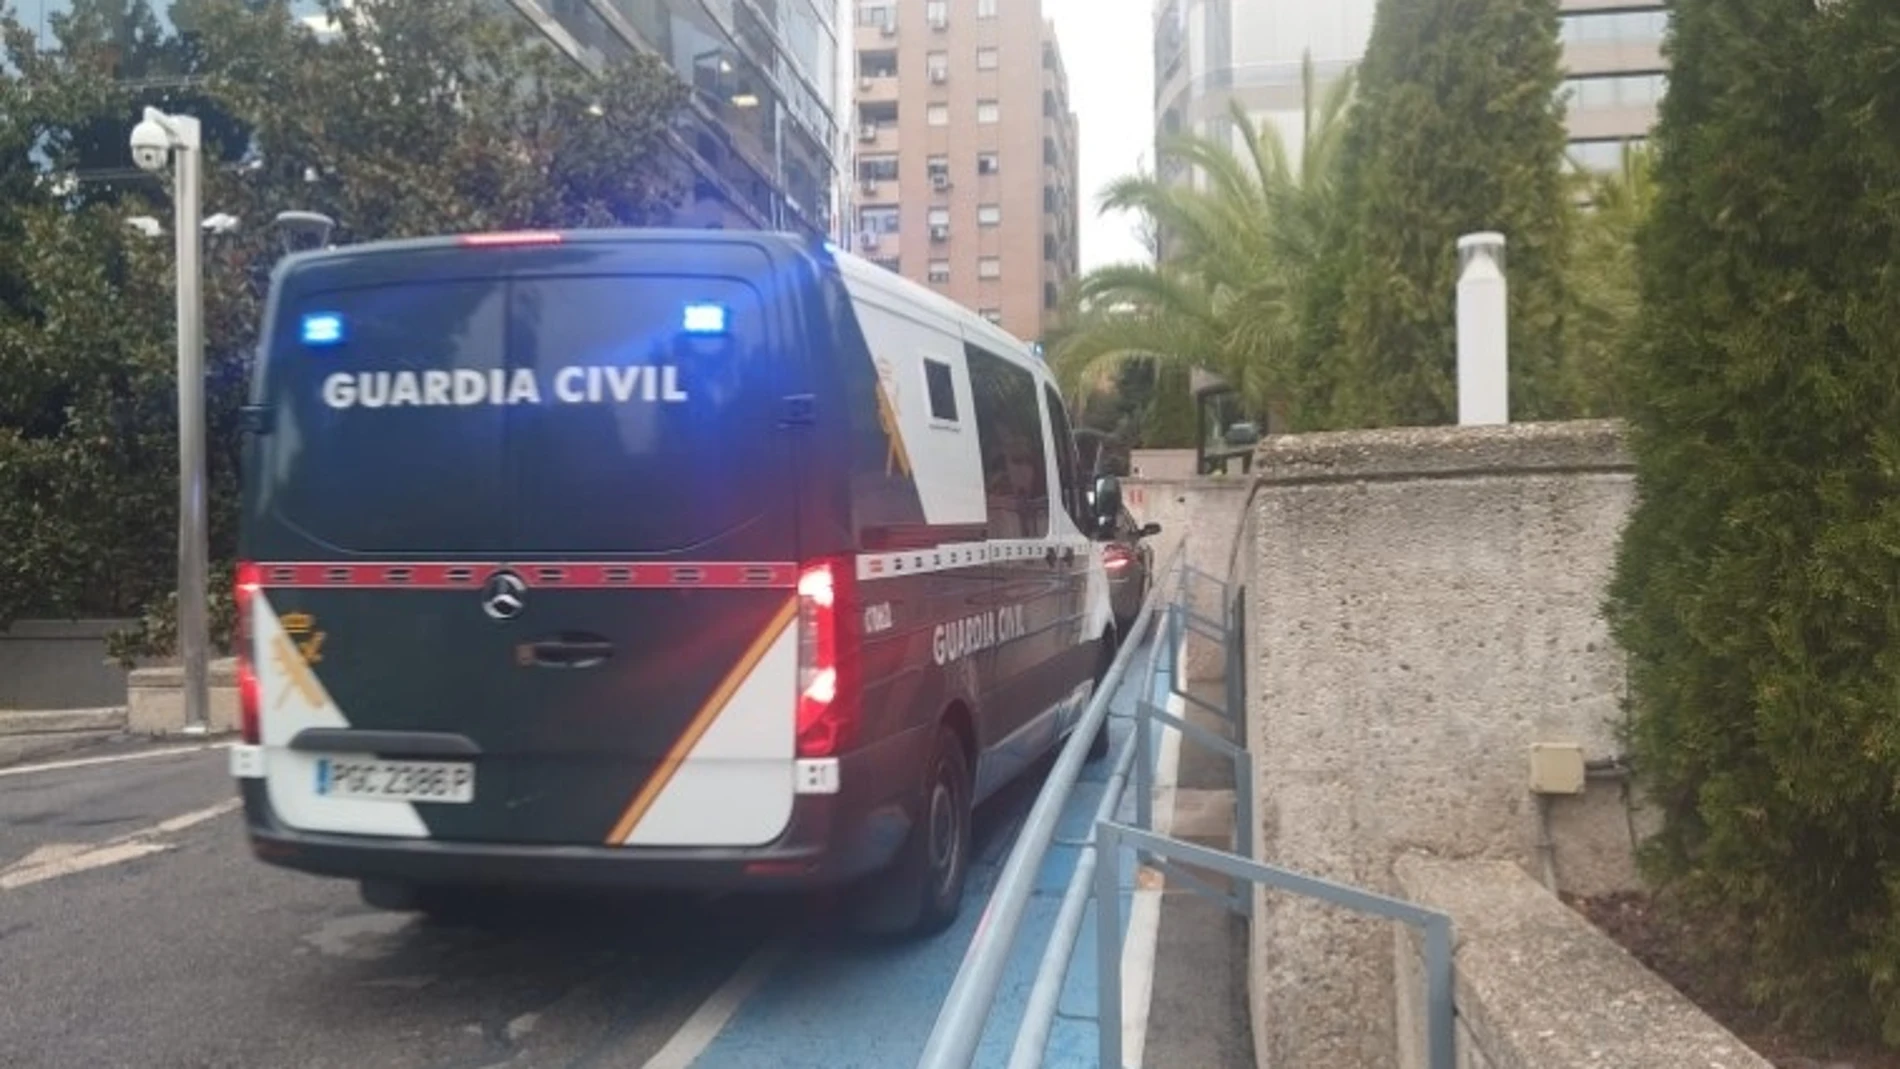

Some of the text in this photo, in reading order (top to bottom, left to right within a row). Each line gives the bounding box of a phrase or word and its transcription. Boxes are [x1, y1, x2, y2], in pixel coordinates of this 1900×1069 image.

[322, 365, 689, 409] GUARDIA CIVIL
[933, 611, 995, 666] GUARDIA
[998, 603, 1026, 643] CIVIL
[332, 763, 377, 795] PGC
[453, 767, 469, 796] P
